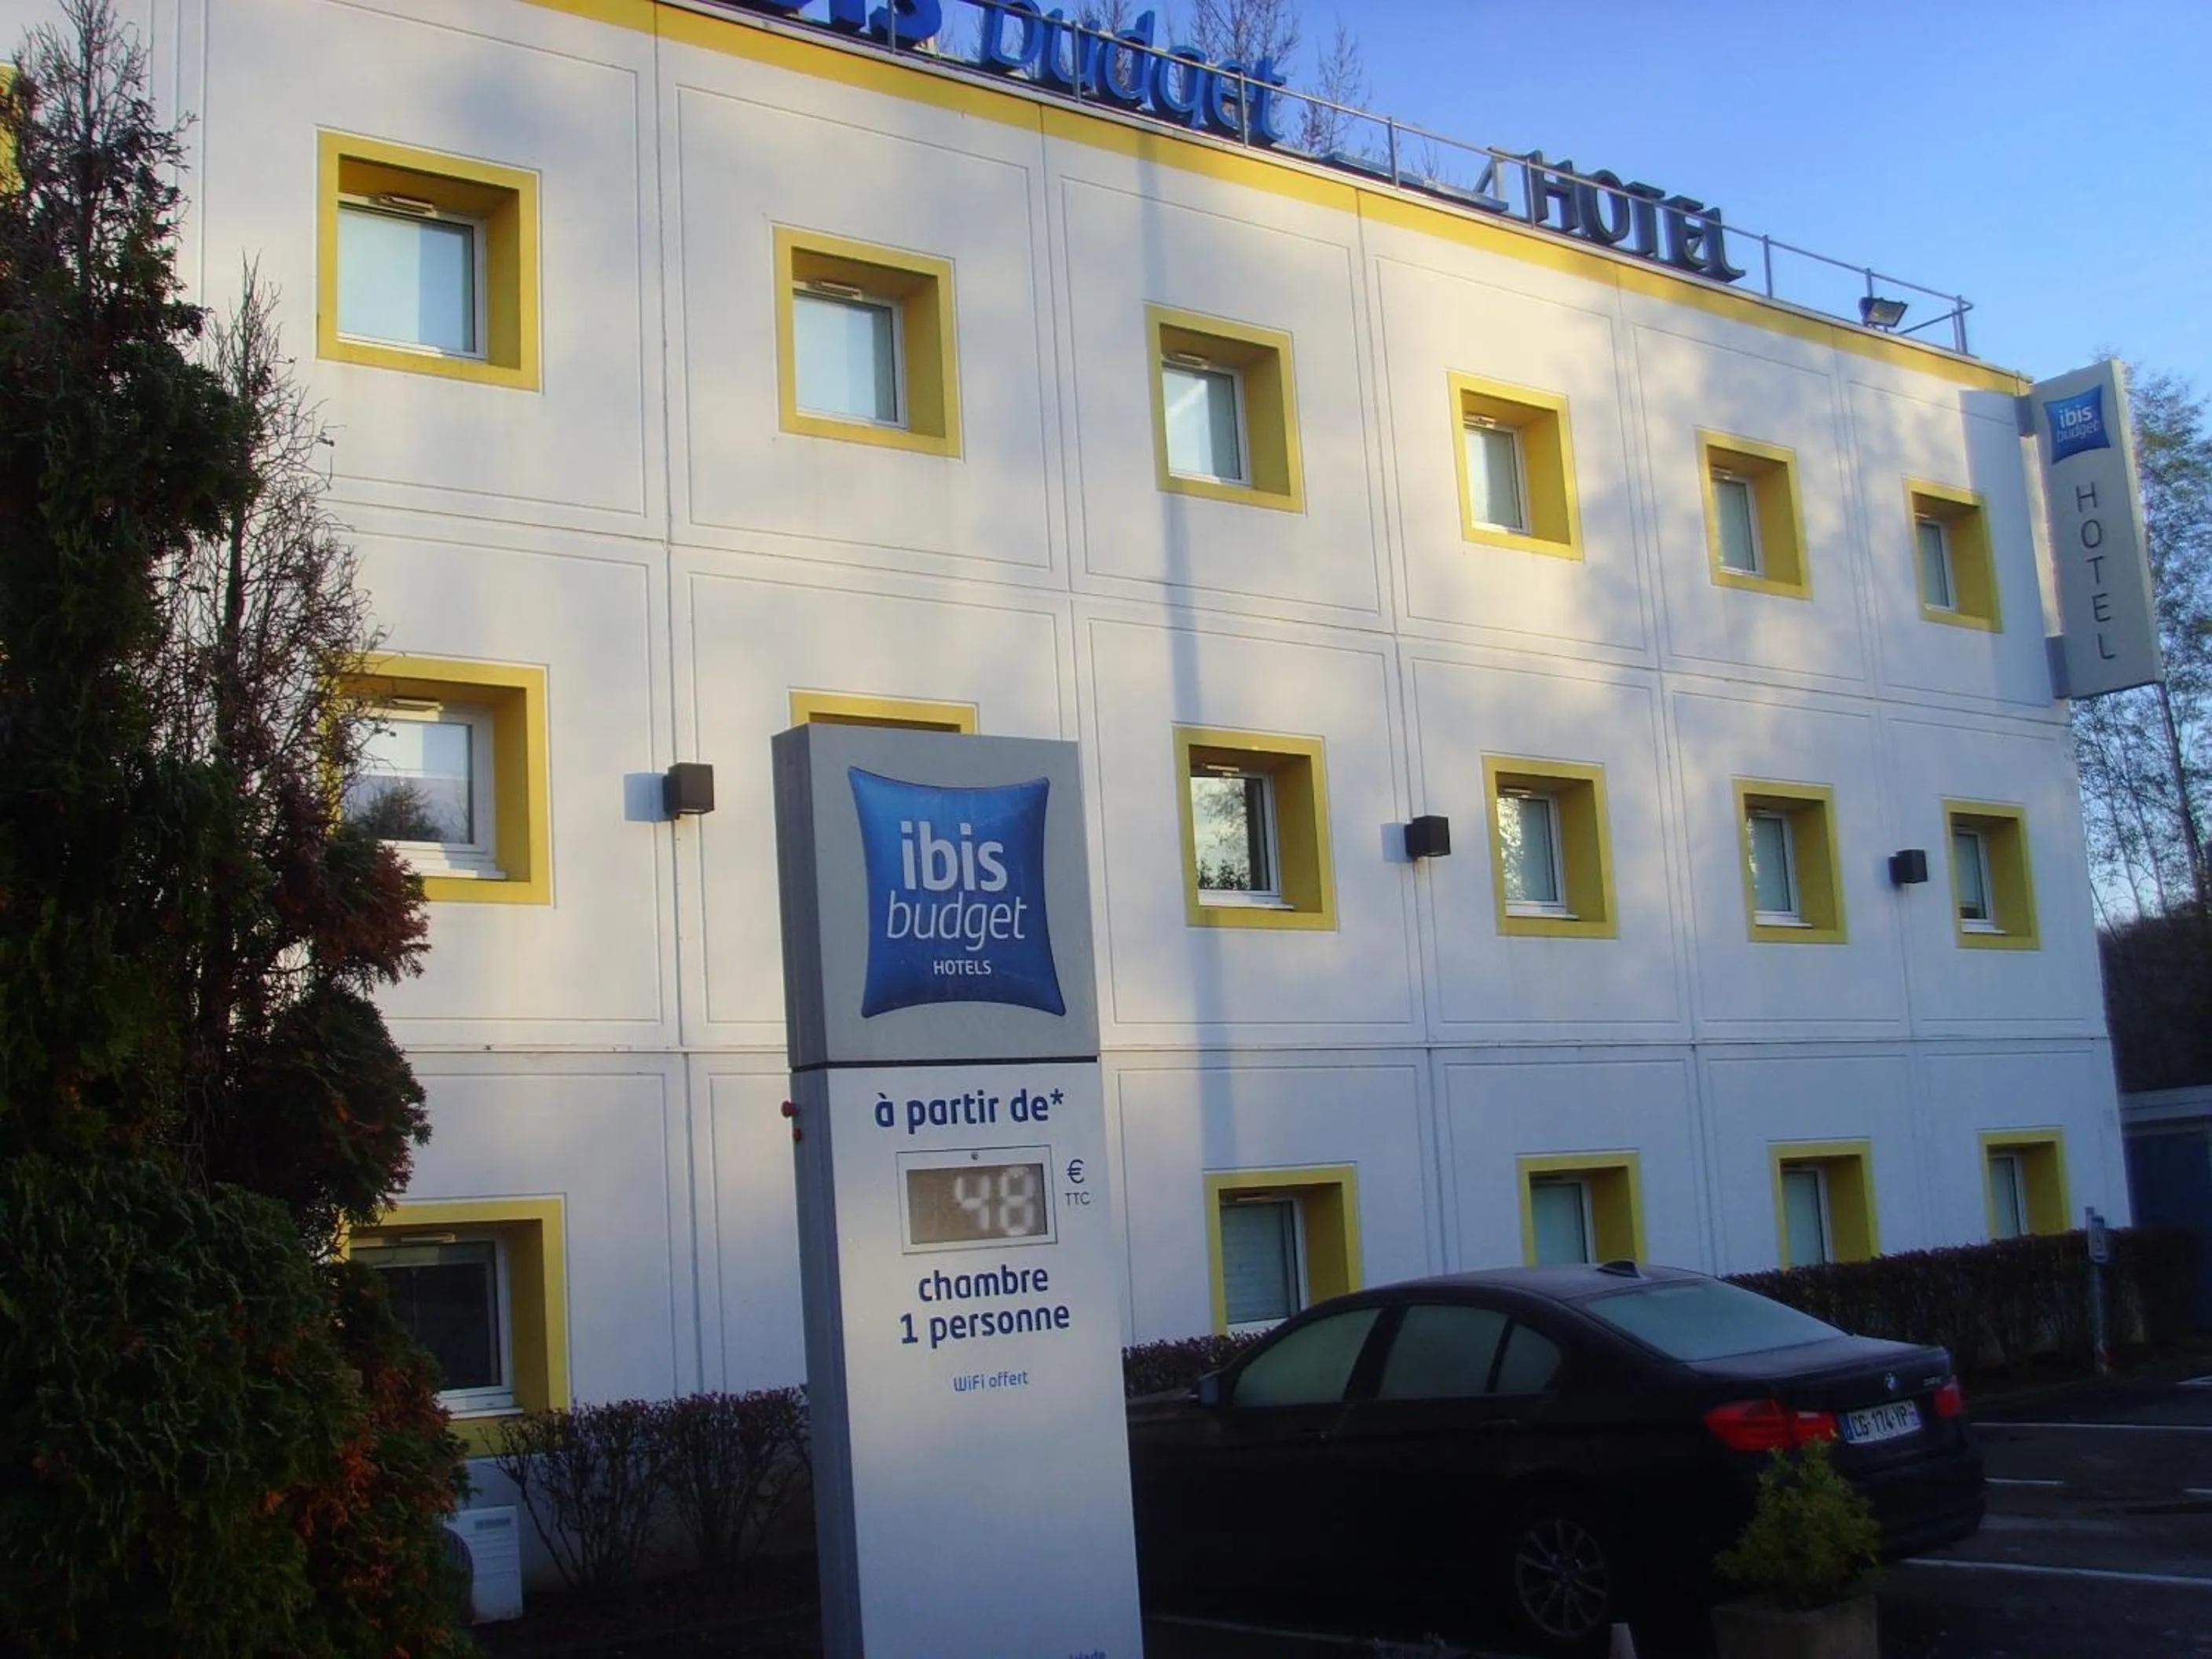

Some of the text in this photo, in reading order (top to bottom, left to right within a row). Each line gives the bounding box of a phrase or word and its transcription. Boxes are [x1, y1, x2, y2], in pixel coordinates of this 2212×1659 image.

[980, 0, 1287, 142] budget
[1521, 149, 1746, 283] HOTEL
[2056, 419, 2100, 443] budget
[2059, 405, 2092, 428] ibis
[2076, 481, 2116, 661] HOTEL
[899, 820, 1009, 892] ibis
[886, 890, 1027, 950] budget
[933, 960, 992, 976] HOTELS
[874, 1093, 895, 1127] à
[906, 1090, 999, 1135] partir
[954, 1166, 1037, 1237] 48
[1064, 1191, 1091, 1207] TTC
[918, 1265, 1049, 1302] chambre
[899, 1305, 1071, 1350] 1 personne
[953, 1371, 1029, 1392] WiFi offert
